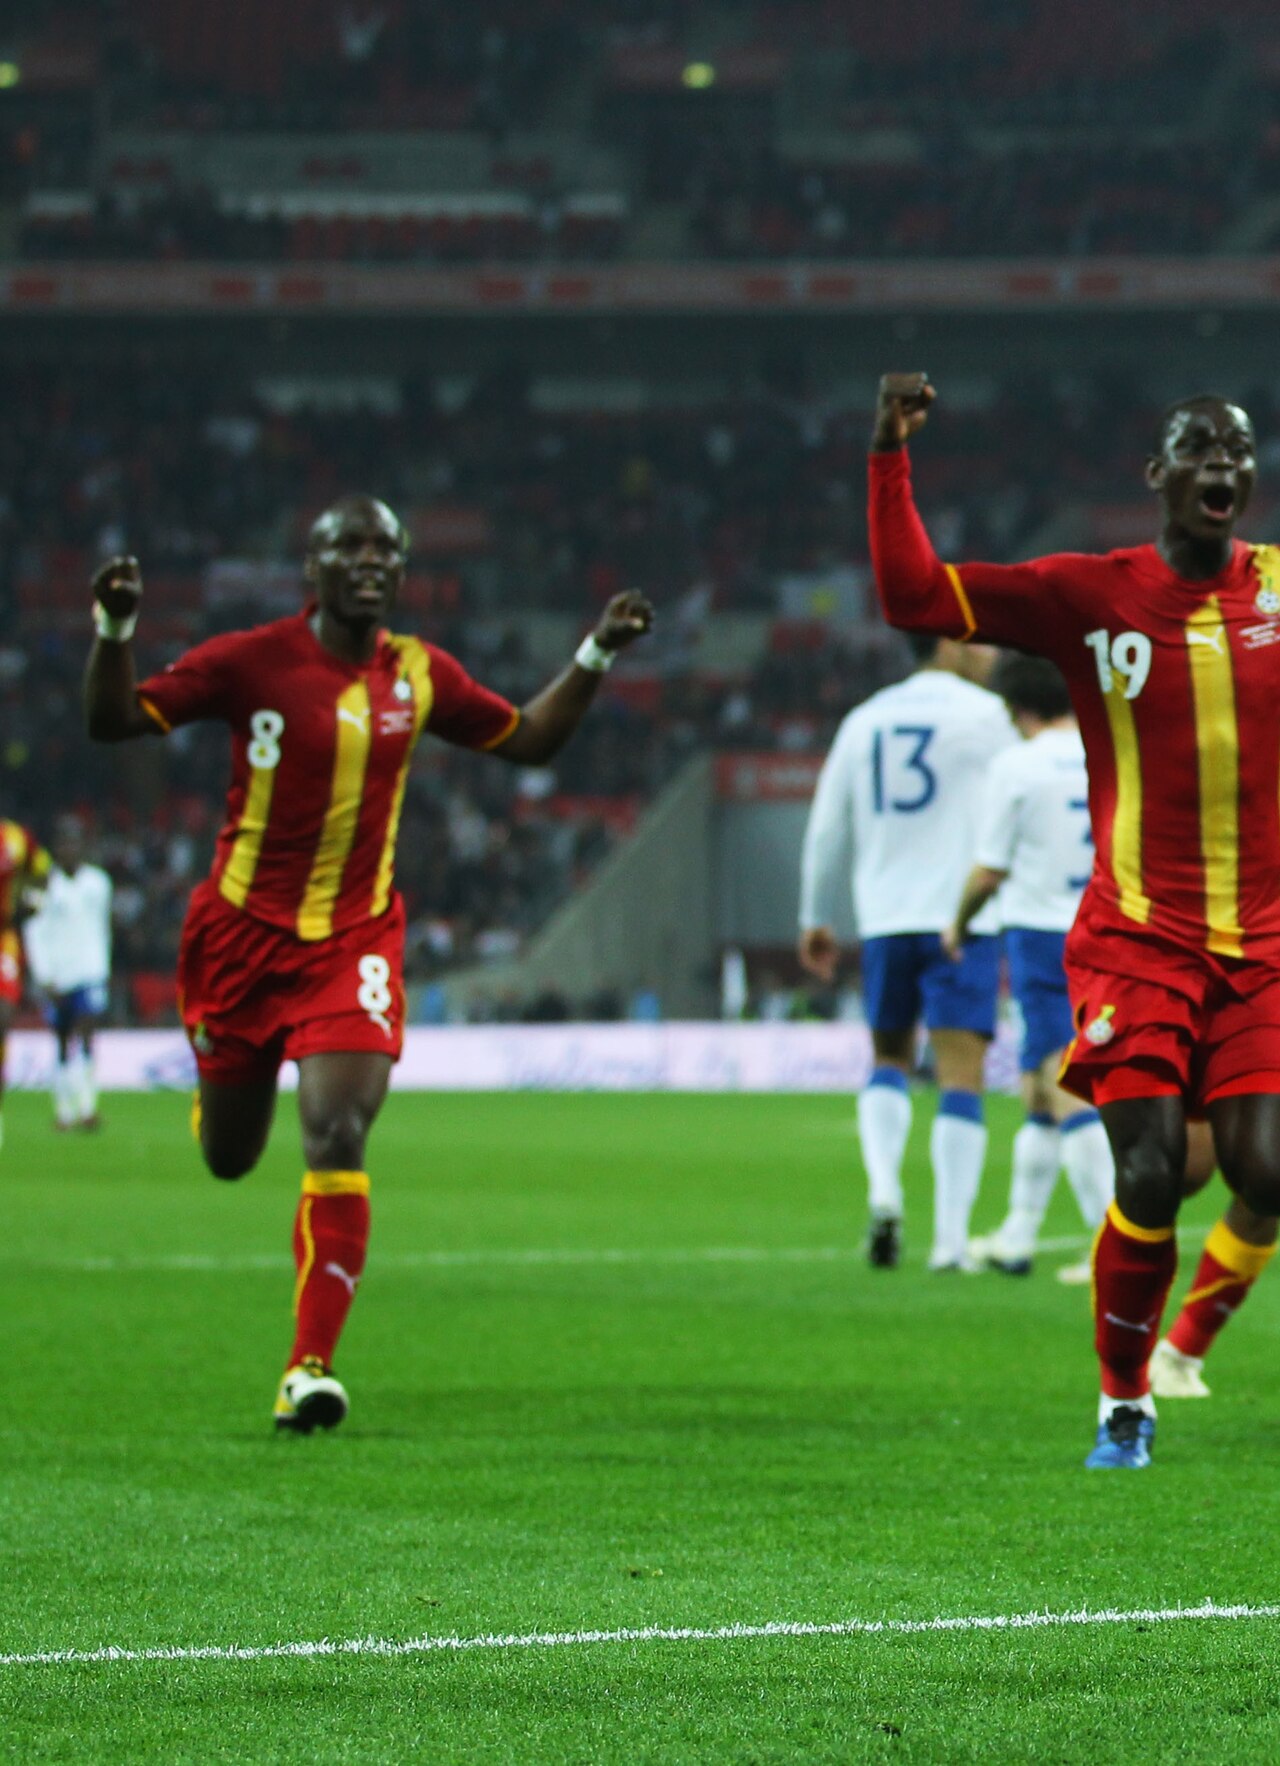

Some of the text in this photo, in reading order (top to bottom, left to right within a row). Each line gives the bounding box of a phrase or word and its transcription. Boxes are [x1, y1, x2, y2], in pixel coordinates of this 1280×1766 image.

[1084, 628, 1152, 700] 19
[246, 708, 285, 770] 8
[872, 722, 937, 816] 13
[357, 953, 393, 1014] 8
